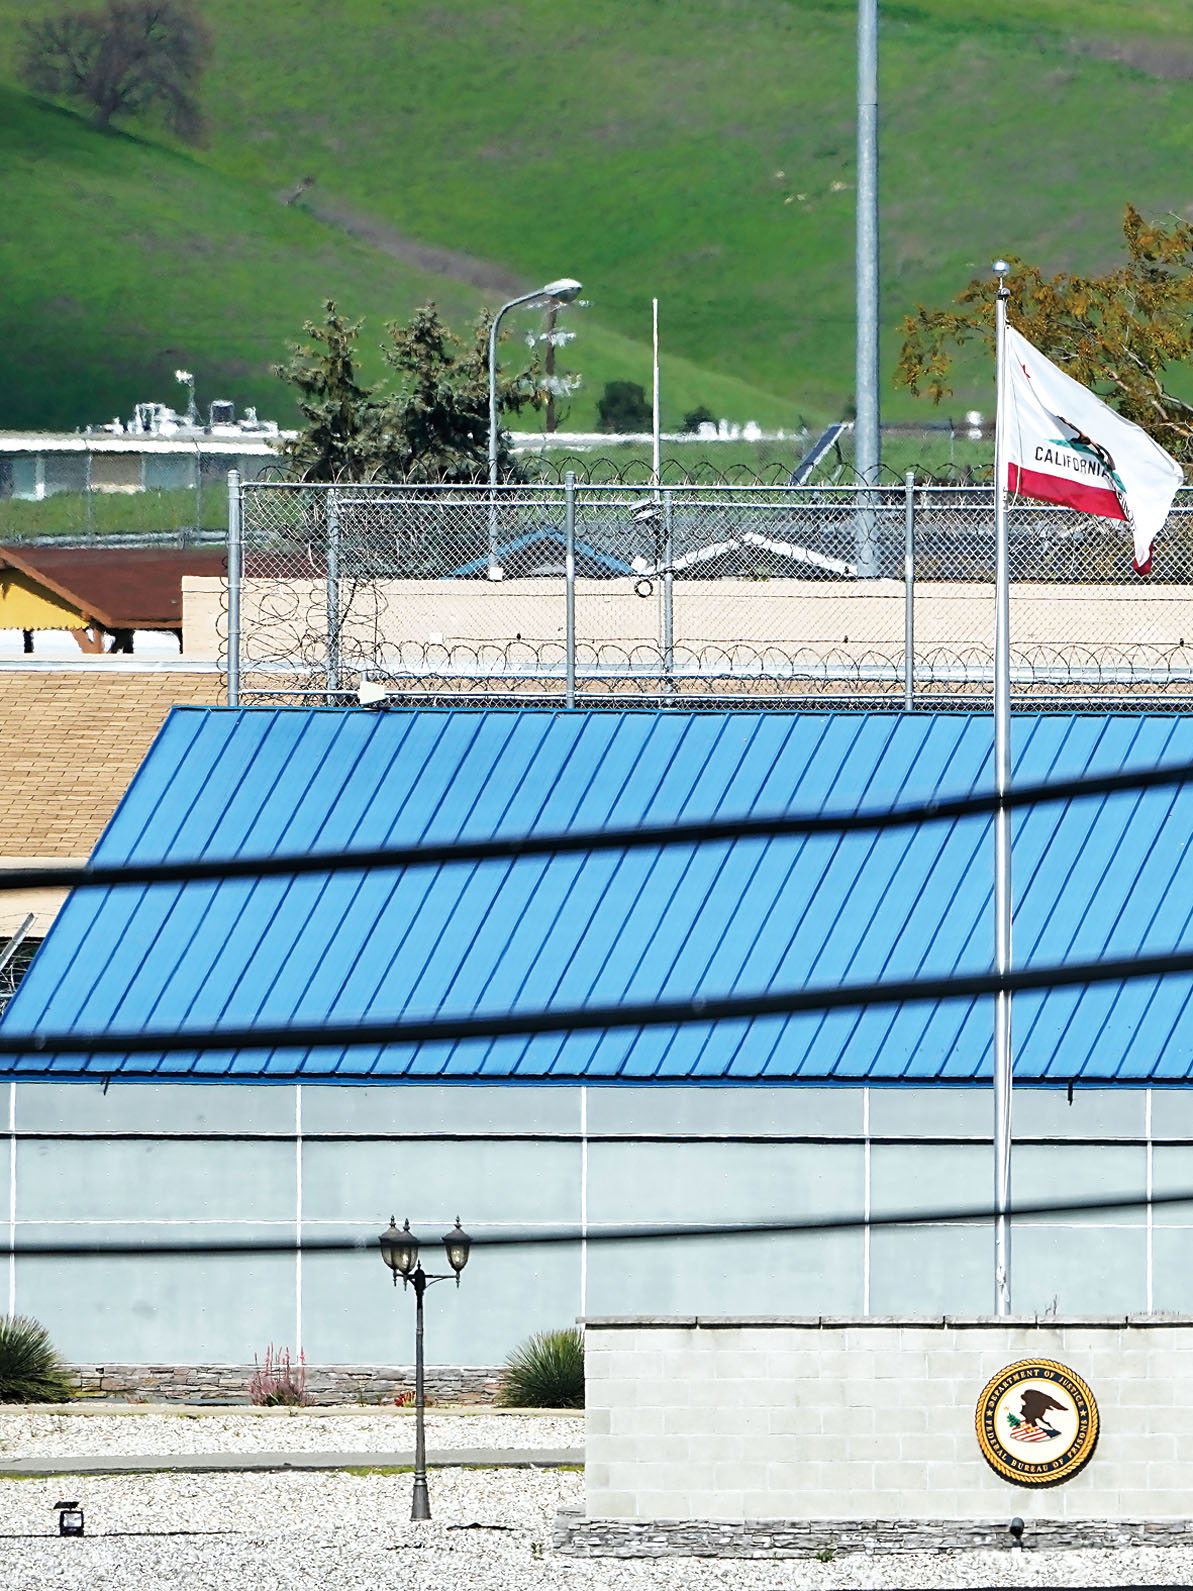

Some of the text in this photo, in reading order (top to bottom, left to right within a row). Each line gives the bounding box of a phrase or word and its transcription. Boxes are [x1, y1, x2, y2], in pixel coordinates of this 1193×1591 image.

[1035, 446, 1110, 480] CALIFORNIA
[988, 1369, 1084, 1408] DEPARTMENT OF JUSTICE
[985, 1419, 1088, 1473] FEDERAL BUREAU OF PRISONS
